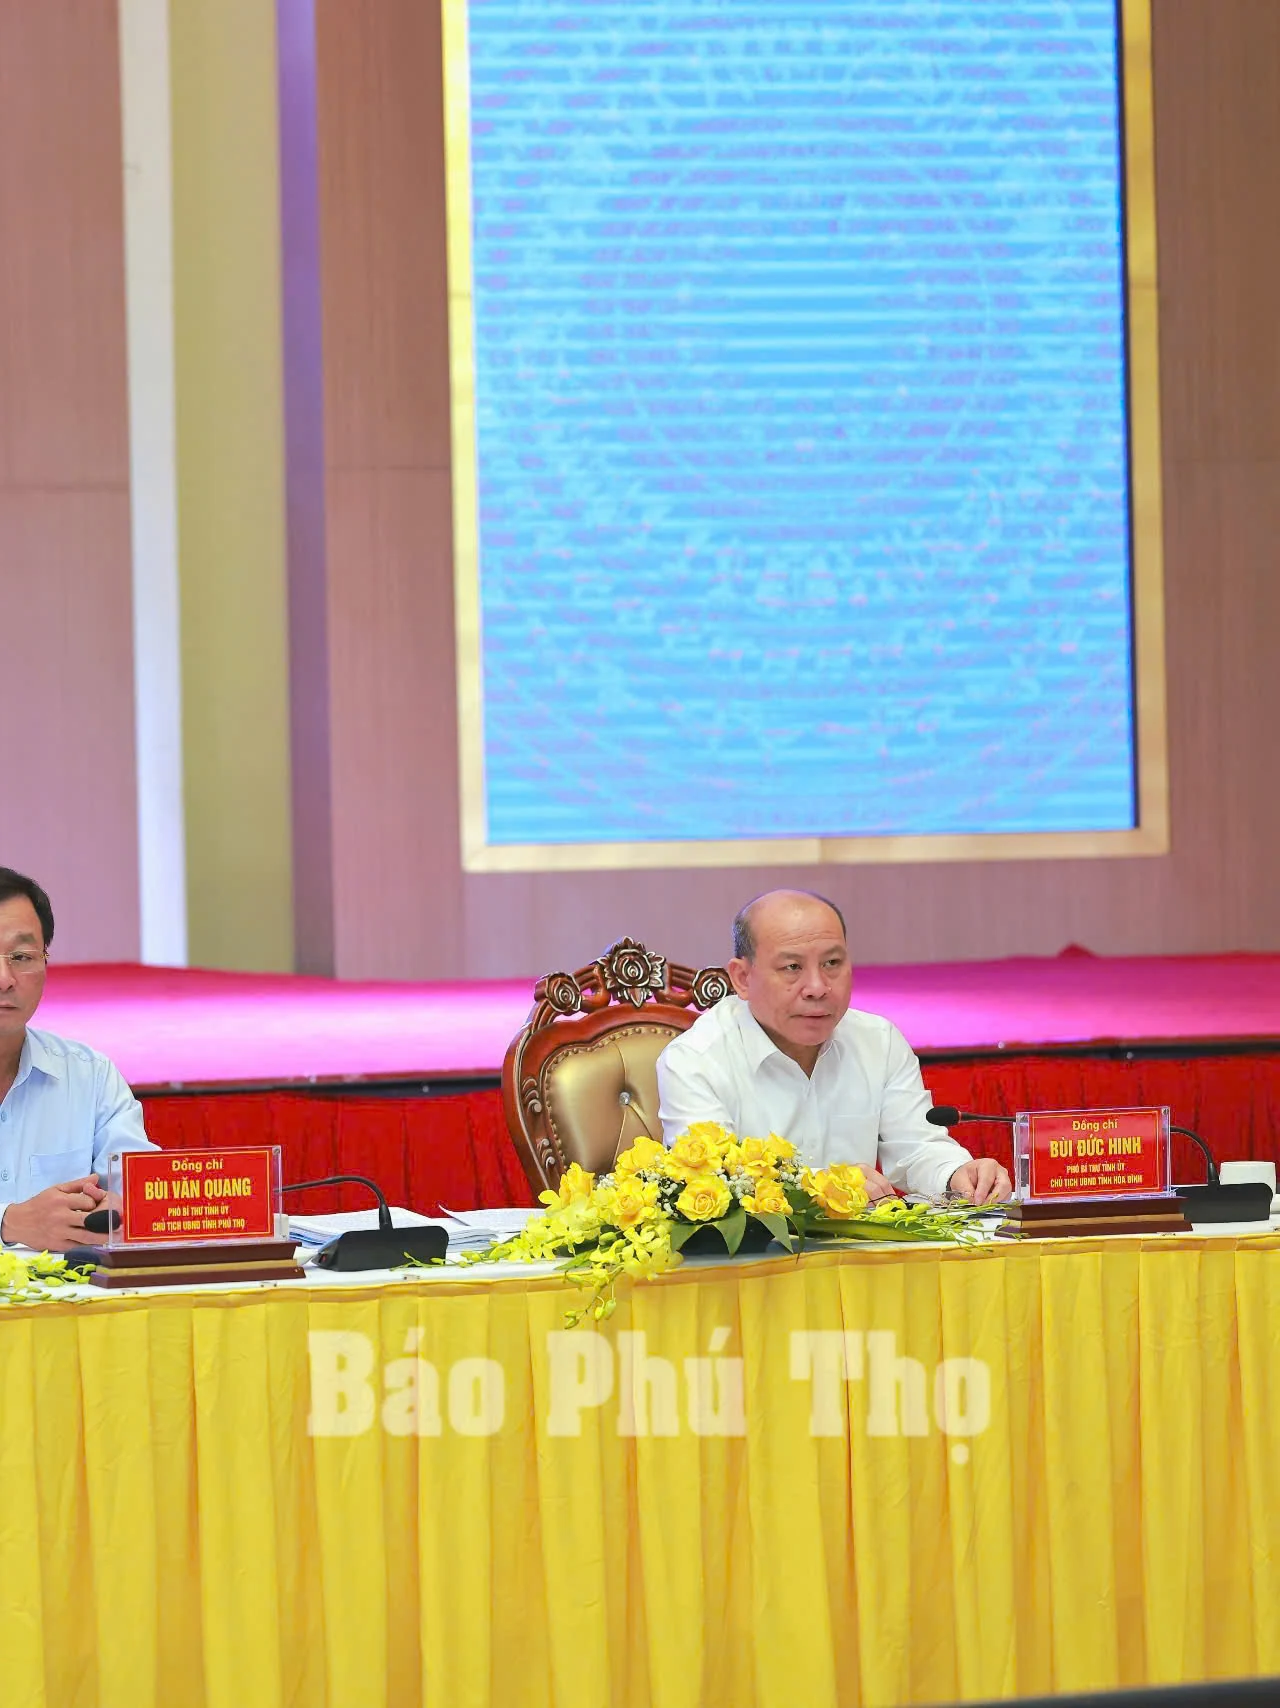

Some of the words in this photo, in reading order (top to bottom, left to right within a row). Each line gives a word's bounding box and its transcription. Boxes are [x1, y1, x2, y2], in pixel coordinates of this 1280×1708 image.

[1102, 1119, 1118, 1130] chí
[1050, 1136, 1072, 1158] BÙI
[1077, 1134, 1104, 1157] ĐỨC
[1109, 1136, 1141, 1155] HINH
[172, 1158, 202, 1173] Đồng
[205, 1158, 223, 1170] chí
[145, 1176, 169, 1200] BÙI
[172, 1176, 200, 1199] VĂN
[204, 1177, 252, 1198] QUANG
[1050, 1175, 1062, 1188] CHỦ
[1064, 1177, 1078, 1189] TỊCH
[1080, 1177, 1096, 1187] UBND
[1098, 1174, 1112, 1185] TỈNH
[168, 1206, 181, 1217] PHÓ
[191, 1206, 204, 1216] THƯ
[205, 1203, 219, 1216] TỈNH
[152, 1217, 166, 1232] CHỦ
[167, 1221, 181, 1232] TỊCH
[183, 1220, 200, 1230] UBND
[202, 1217, 217, 1229] TỈNH
[218, 1218, 231, 1228] PHÚ
[232, 1219, 245, 1231] THỌ
